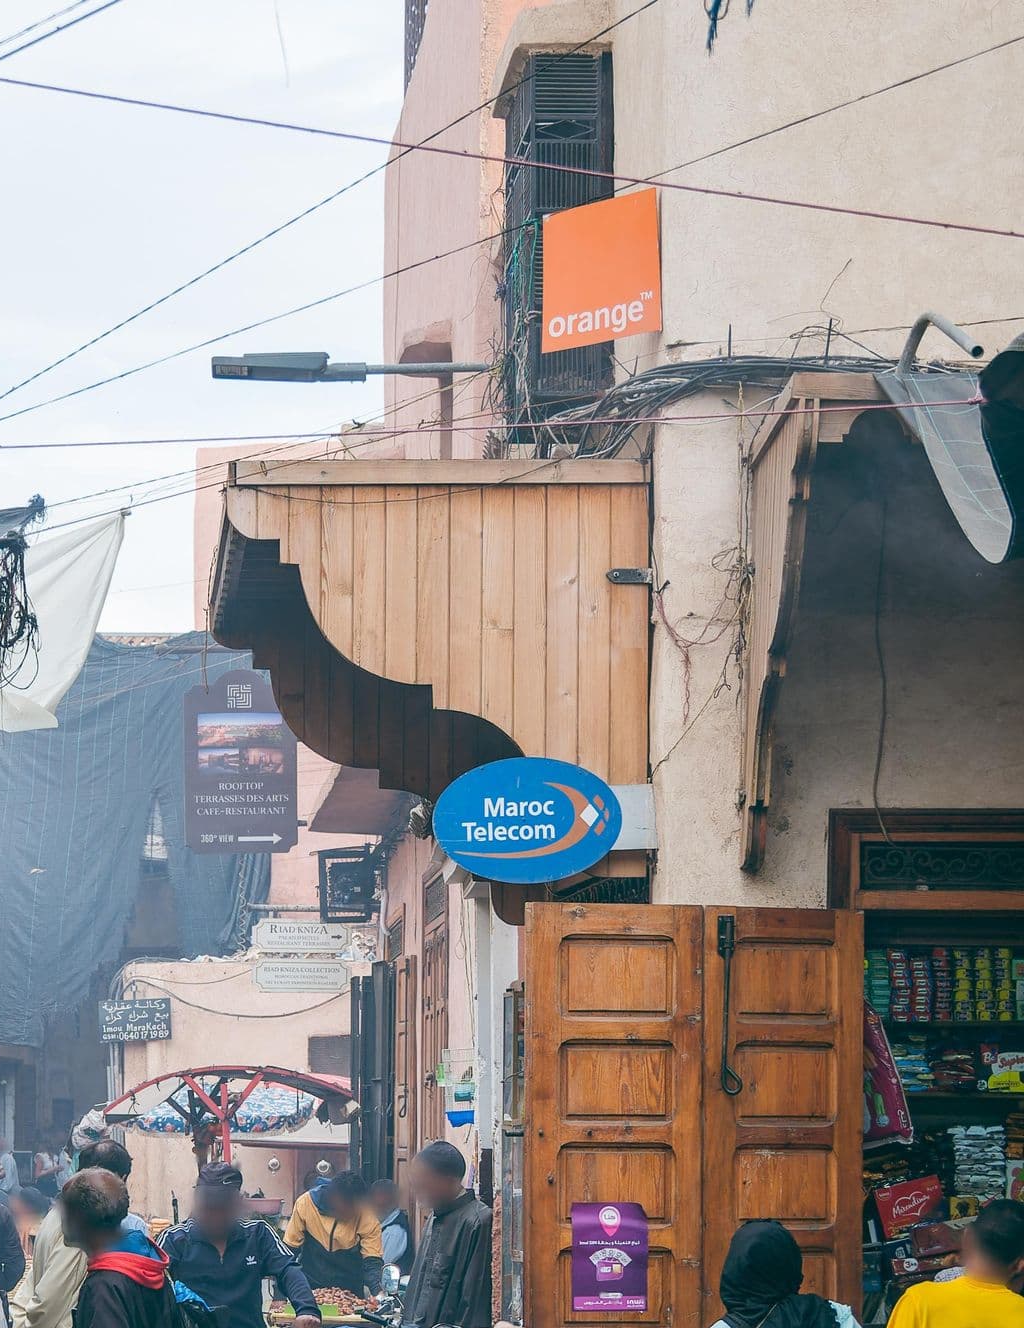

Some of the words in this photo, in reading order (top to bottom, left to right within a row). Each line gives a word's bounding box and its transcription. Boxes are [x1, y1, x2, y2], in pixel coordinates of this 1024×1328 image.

[218, 782, 264, 791] ROOFTOP
[194, 795, 244, 804] TERRASSES
[246, 795, 264, 803] DES
[266, 794, 289, 803] ARTS
[484, 797, 555, 818] Maroc
[462, 821, 556, 842] Telecom
[219, 834, 234, 843] VIEW
[102, 1002, 133, 1014] عقارية
[134, 999, 166, 1010] وكالة
[154, 1012, 169, 1022] بيع
